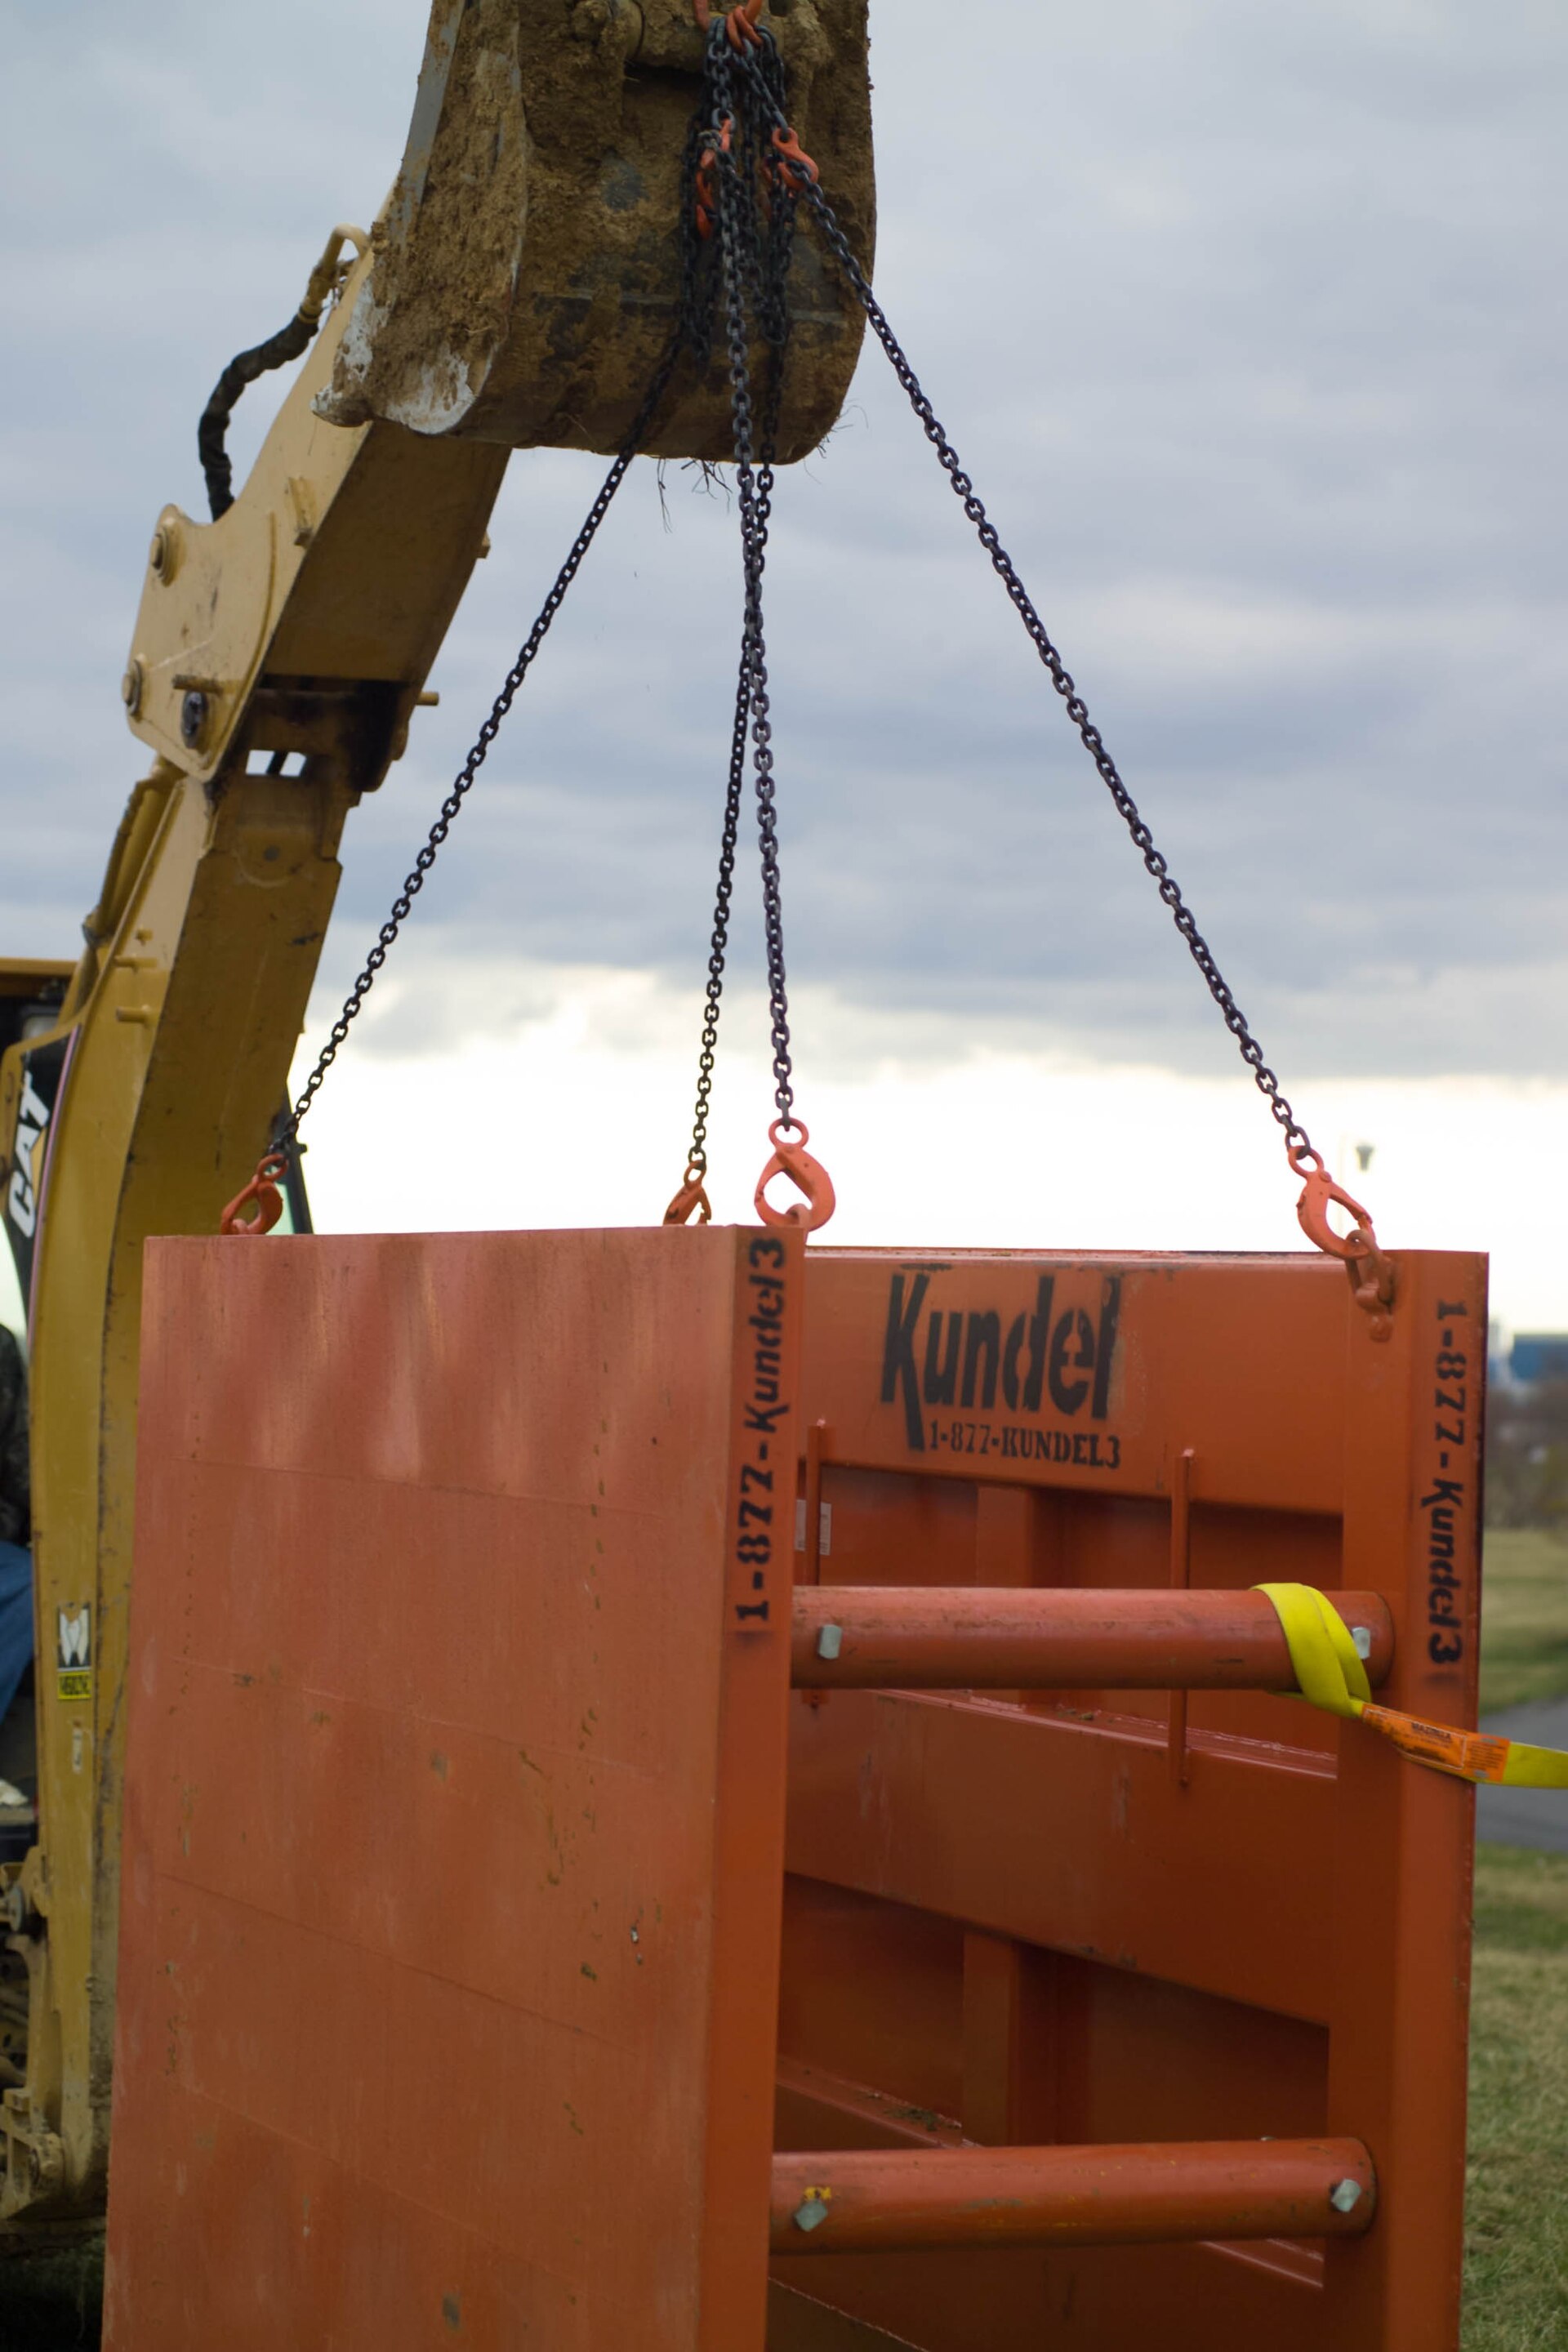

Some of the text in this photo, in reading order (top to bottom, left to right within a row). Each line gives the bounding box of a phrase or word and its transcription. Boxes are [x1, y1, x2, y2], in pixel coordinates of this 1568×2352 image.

[9, 1070, 50, 1238] CAT
[880, 1273, 1121, 1452] Kundel
[929, 1420, 1120, 1469] 1-877-KUNDEL3
